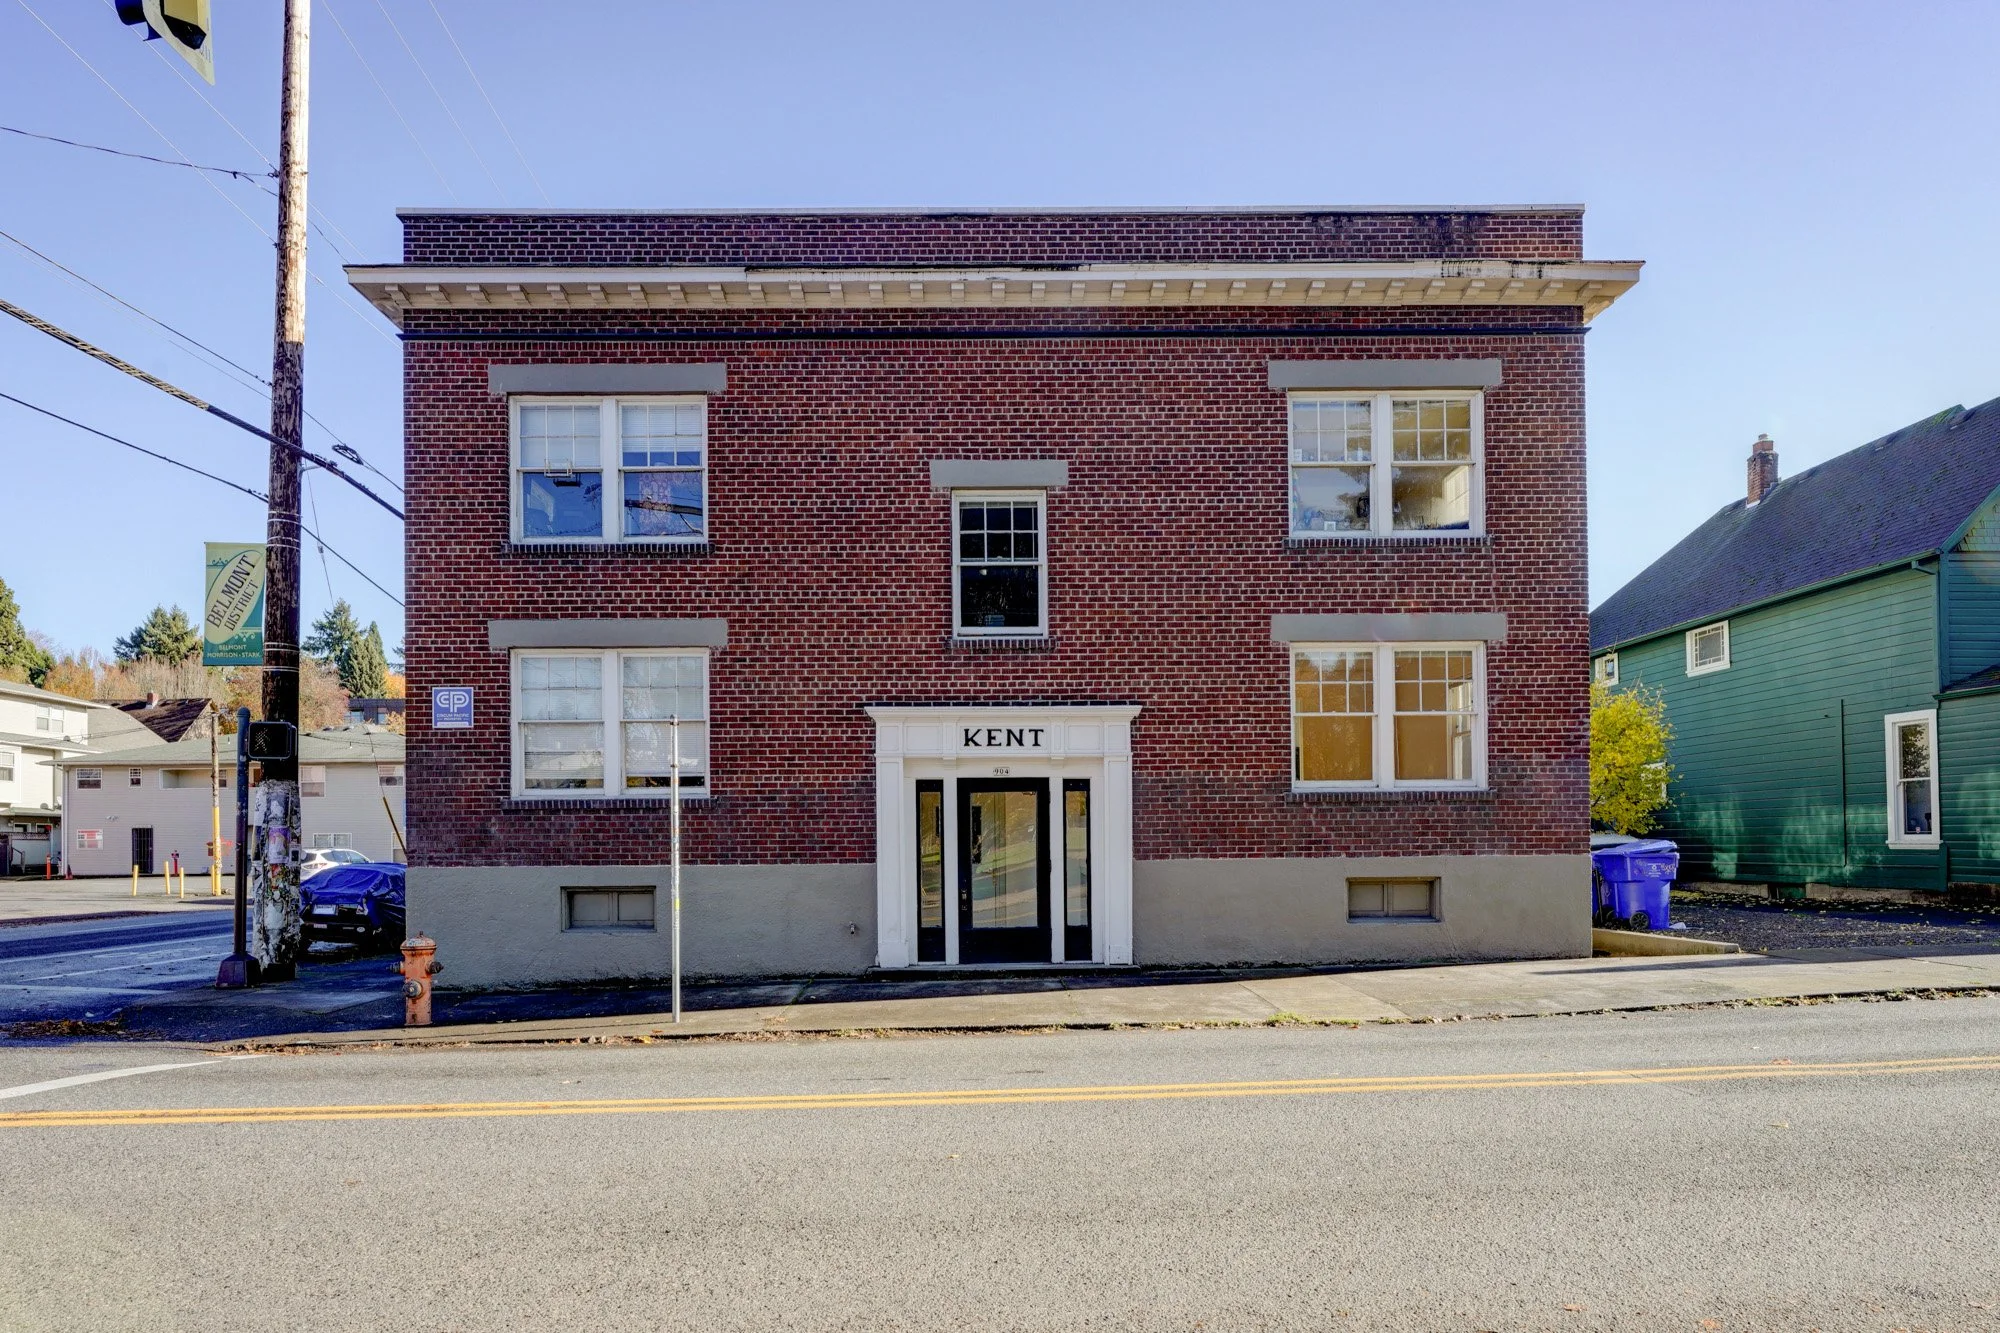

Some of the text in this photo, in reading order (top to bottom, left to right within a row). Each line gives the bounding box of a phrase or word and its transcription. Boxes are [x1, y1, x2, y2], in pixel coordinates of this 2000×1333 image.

[206, 554, 256, 628] BELMONT
[224, 580, 259, 631] DISTRICT
[963, 728, 1045, 747] KENT
[994, 767, 1010, 775] 904
